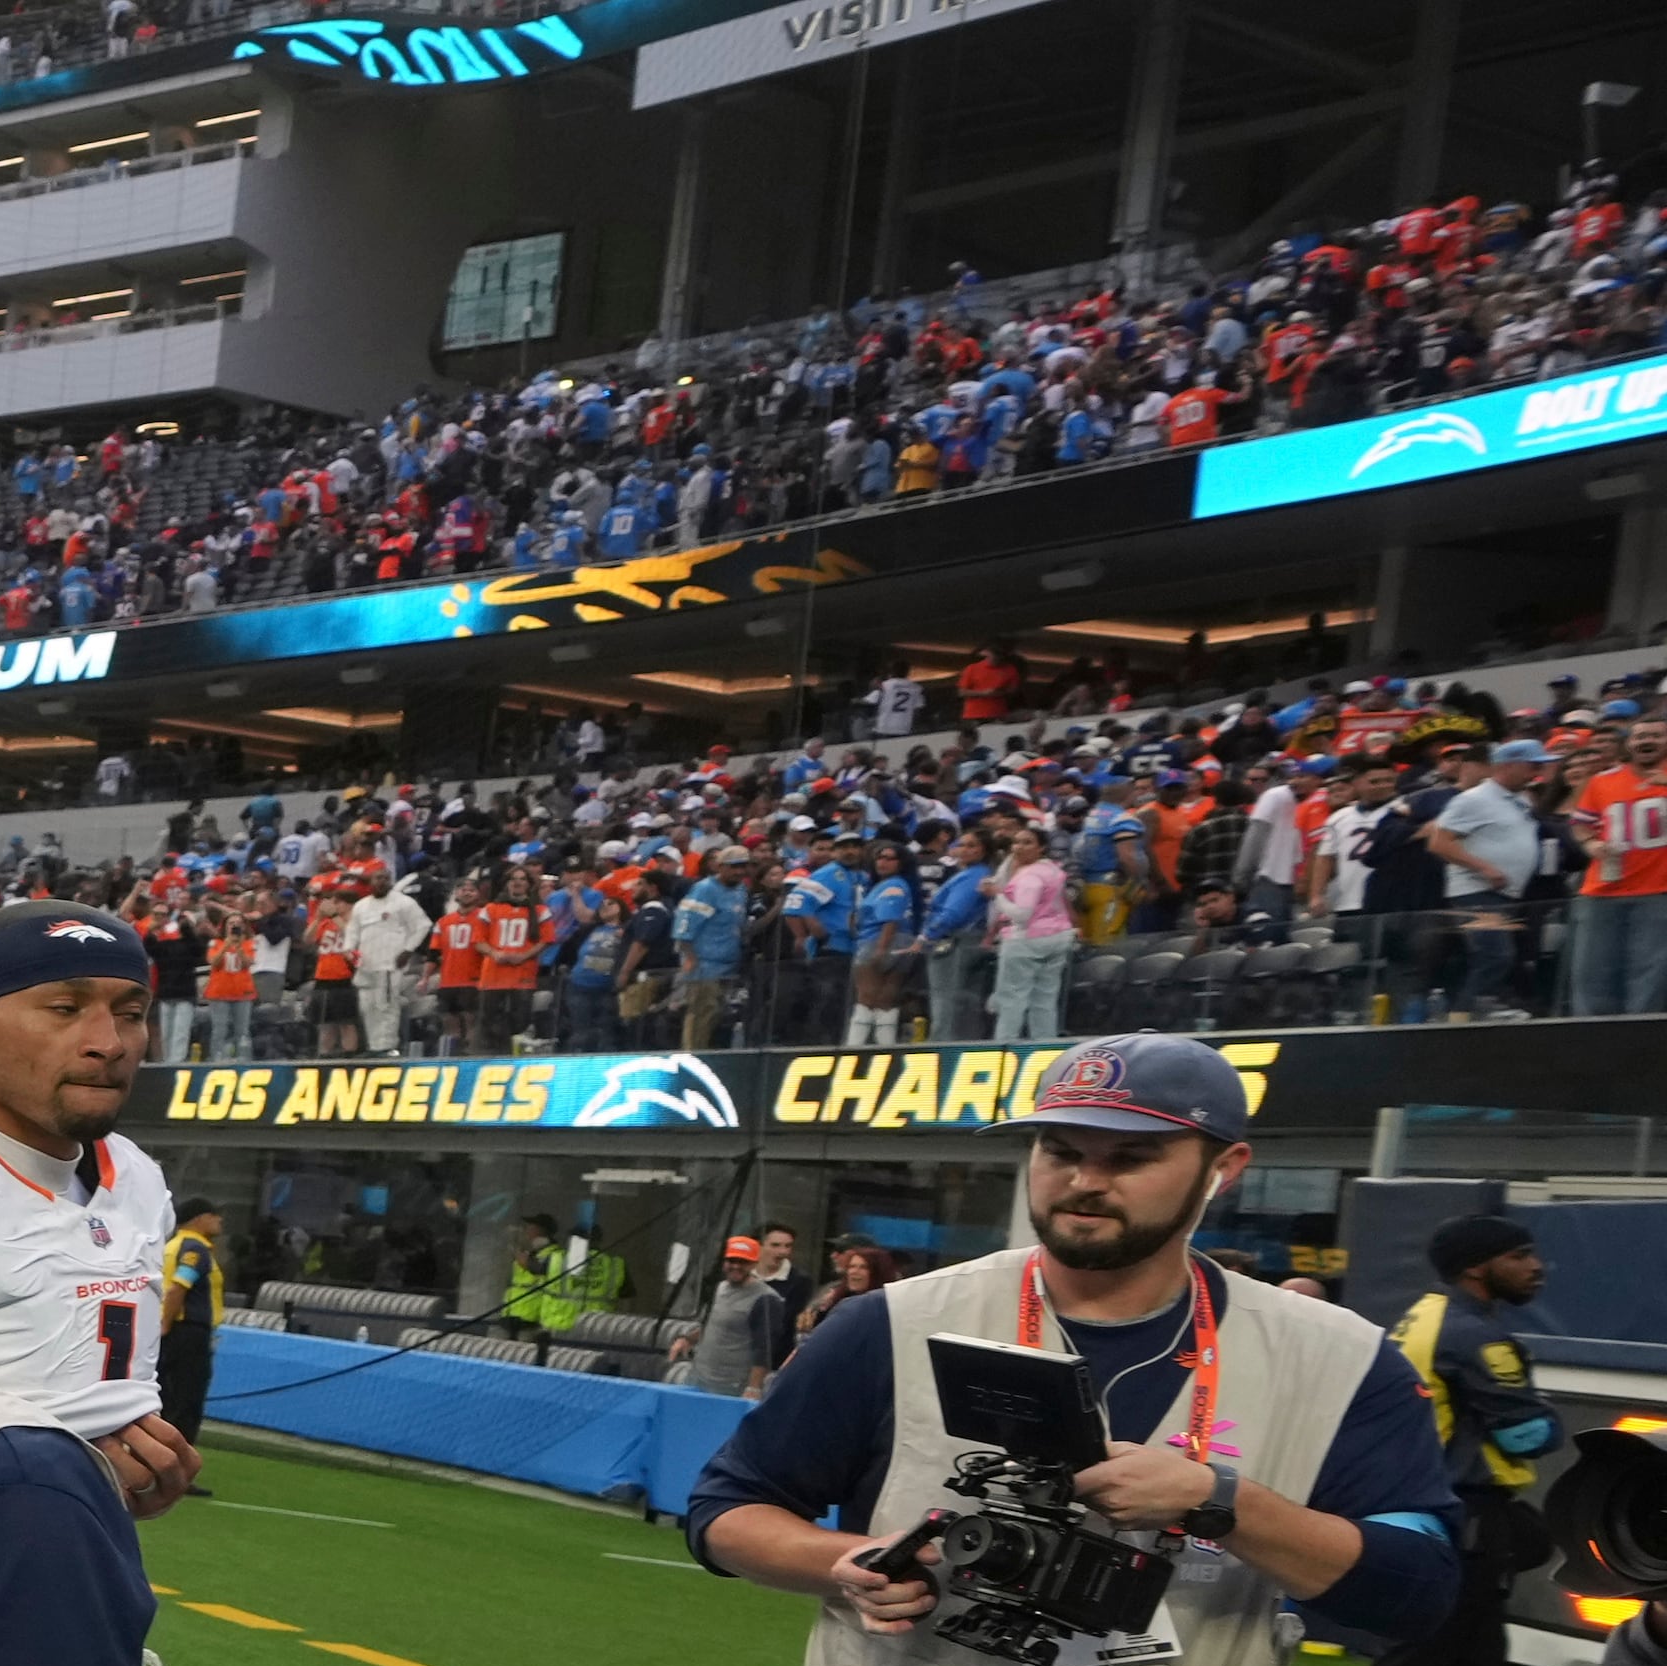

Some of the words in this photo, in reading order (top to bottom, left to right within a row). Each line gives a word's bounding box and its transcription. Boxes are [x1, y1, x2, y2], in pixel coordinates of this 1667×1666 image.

[1516, 375, 1621, 436] BOLT
[1617, 364, 1667, 414] UP
[891, 690, 912, 713] 2
[1606, 797, 1667, 852] 10
[449, 923, 472, 950] 10
[498, 919, 525, 948] 10
[167, 1069, 273, 1120] LOS
[274, 1065, 555, 1124] ANGELES
[76, 1276, 151, 1299] BRONCOS
[98, 1299, 138, 1381] 1
